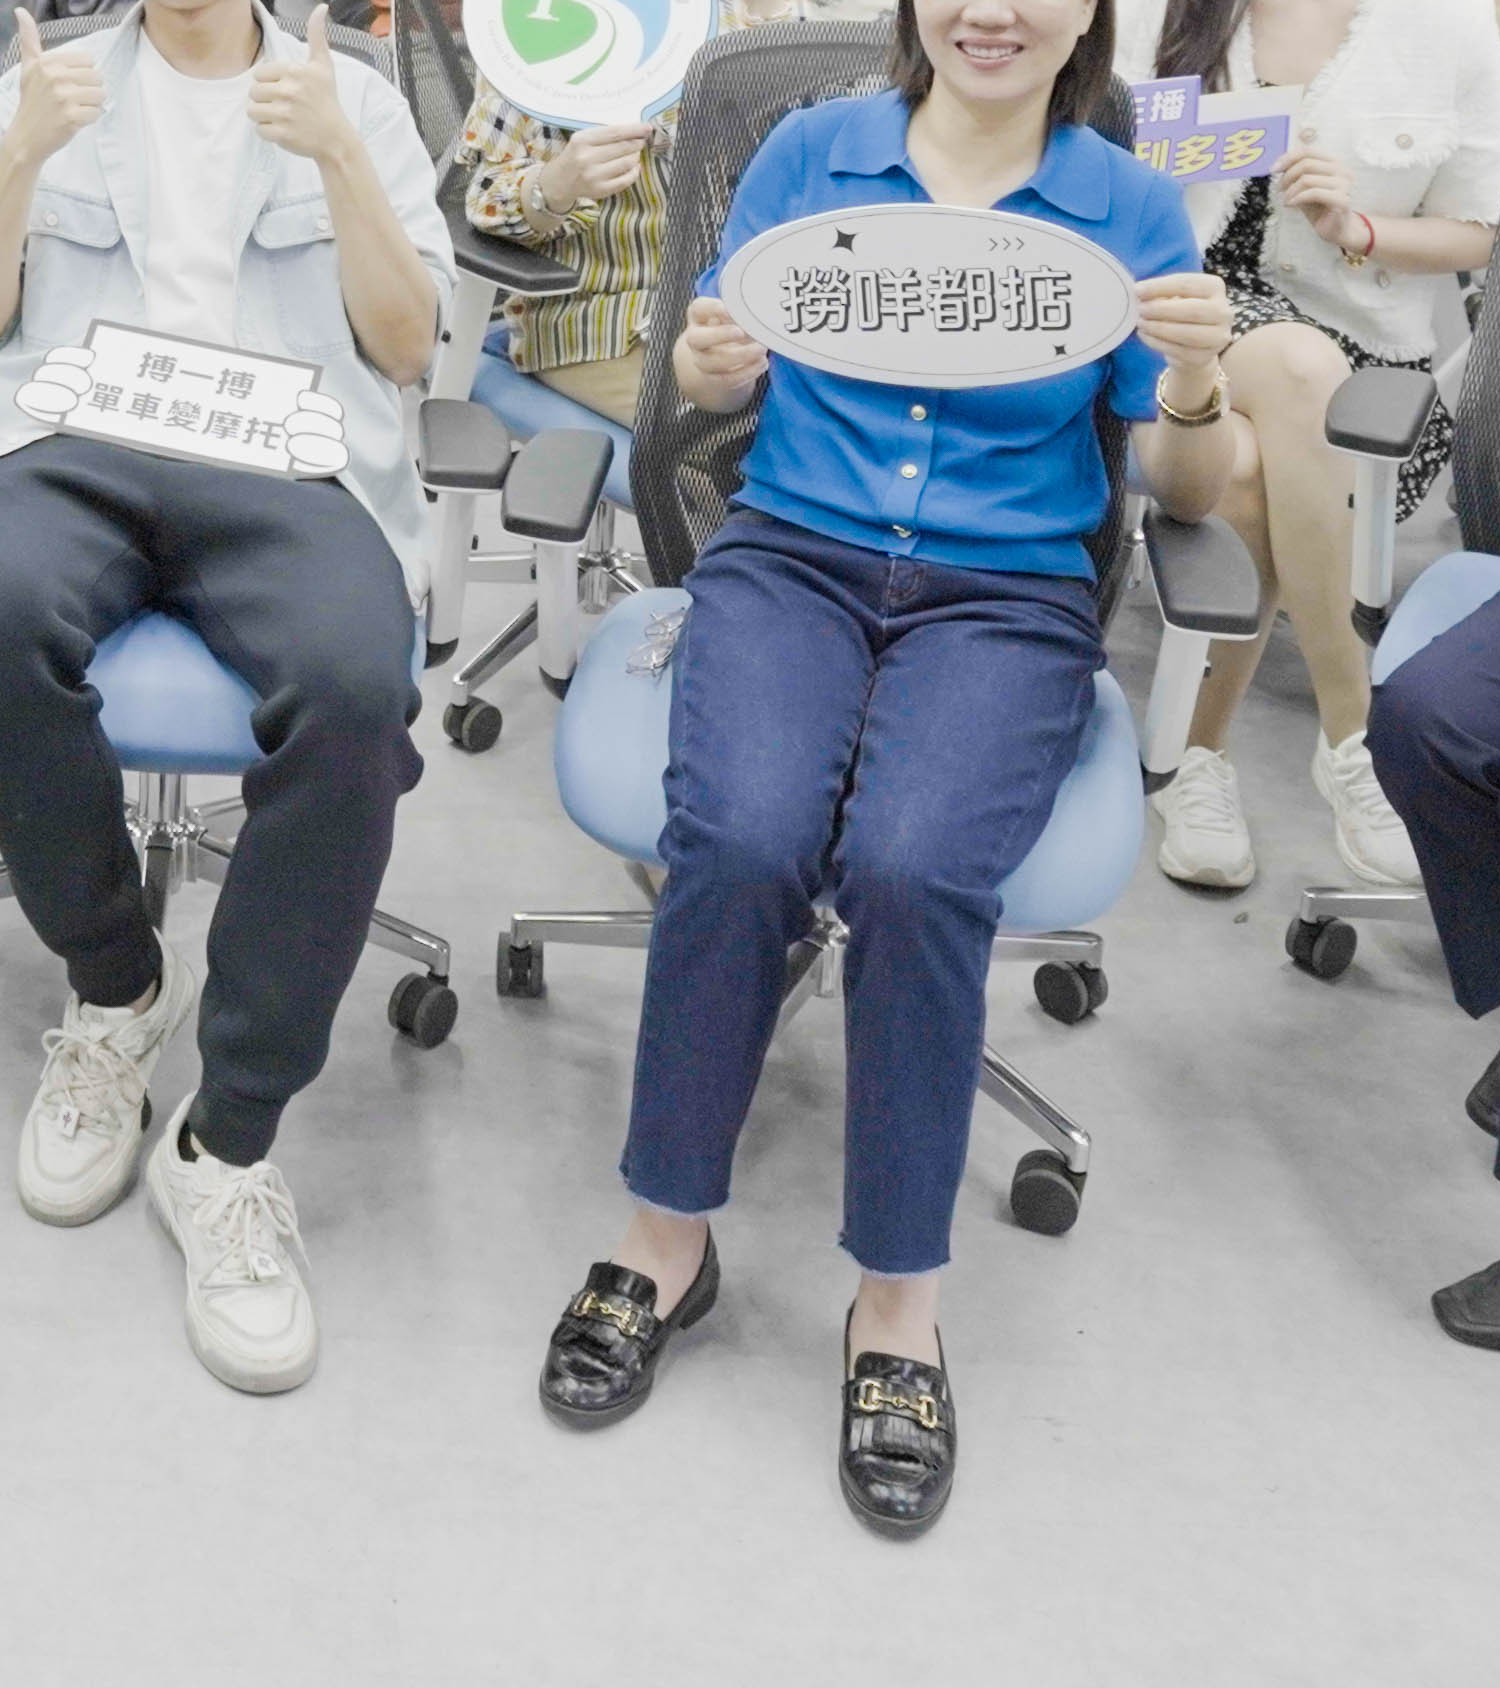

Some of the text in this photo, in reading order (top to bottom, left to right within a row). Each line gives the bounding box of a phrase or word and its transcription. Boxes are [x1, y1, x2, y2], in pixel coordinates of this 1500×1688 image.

[779, 264, 1073, 335] 撈咩都掂
[135, 350, 257, 402] 搏一搏
[87, 380, 284, 452] 單車變摩托
